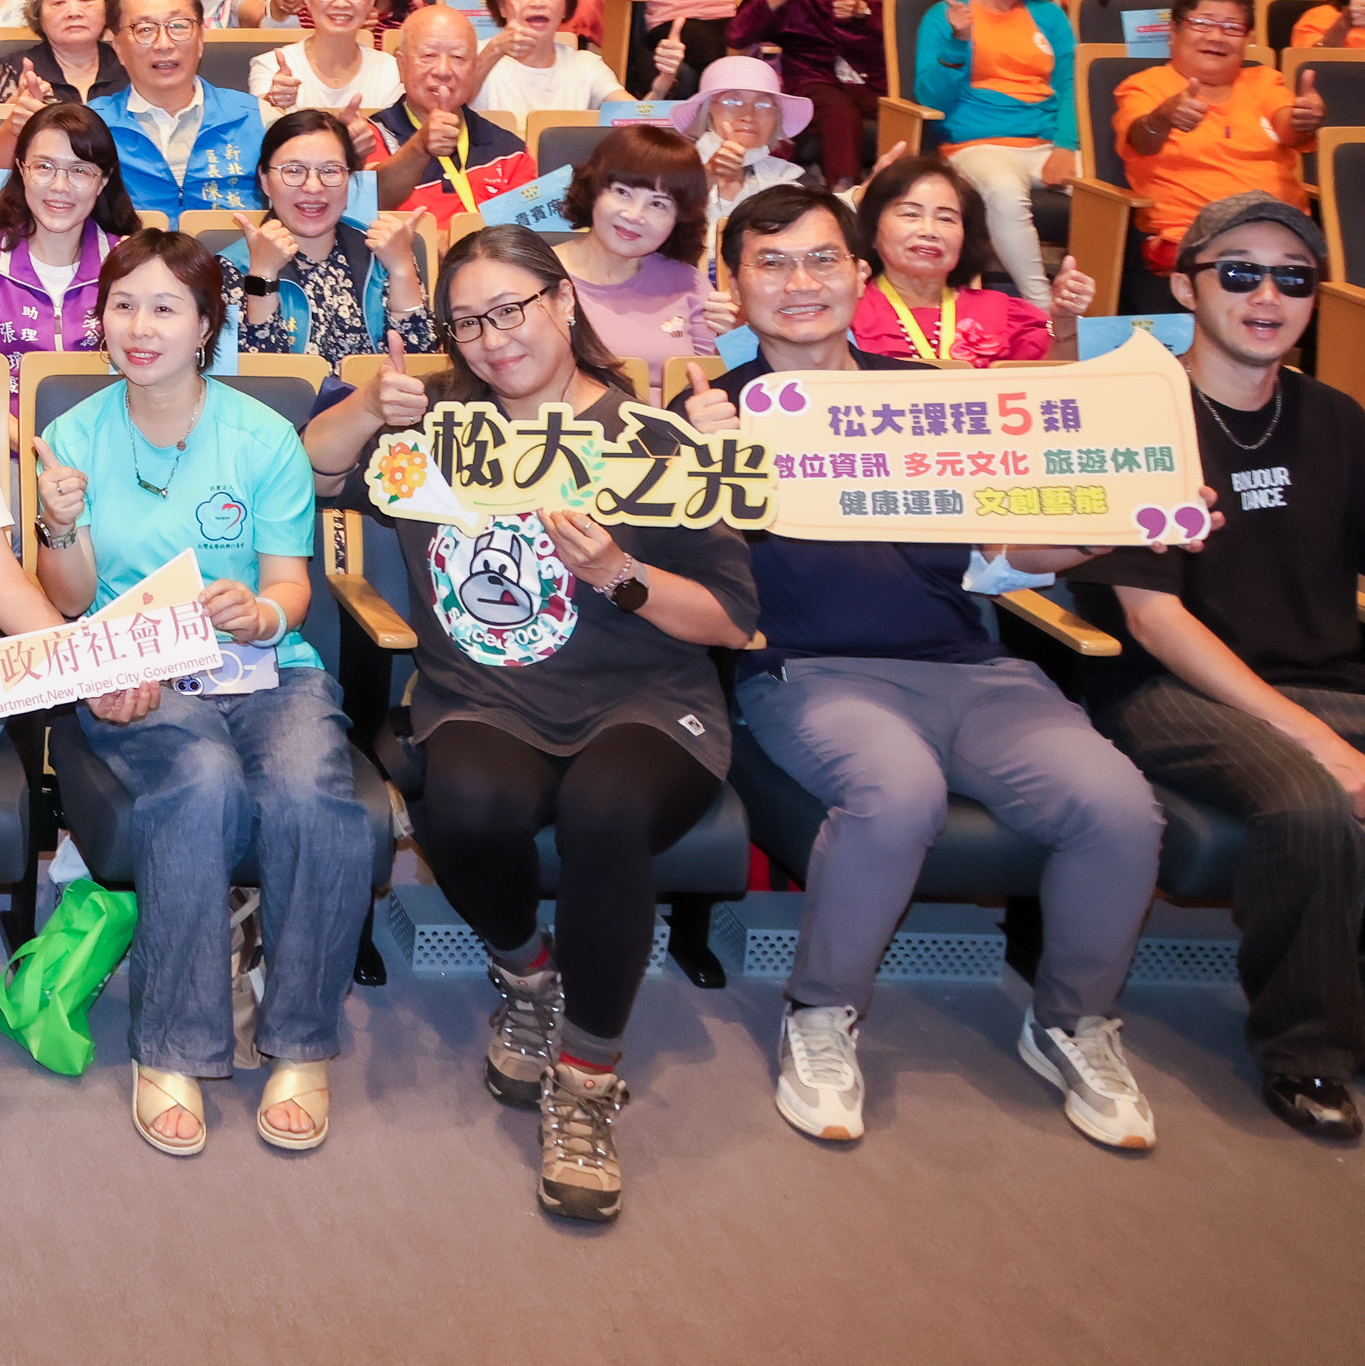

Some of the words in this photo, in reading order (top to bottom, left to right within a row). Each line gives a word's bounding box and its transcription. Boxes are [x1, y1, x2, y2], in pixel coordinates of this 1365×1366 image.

[20, 305, 39, 342] 助理
[433, 411, 771, 523] 松大之光
[904, 451, 1029, 478] 多元文化
[1043, 447, 1175, 475] 旅遊休閒
[839, 489, 964, 516] 健康運動
[974, 486, 1109, 516] 文創藝能
[78, 676, 113, 697] Taipei
[116, 671, 141, 689] City
[143, 653, 219, 678] Government
